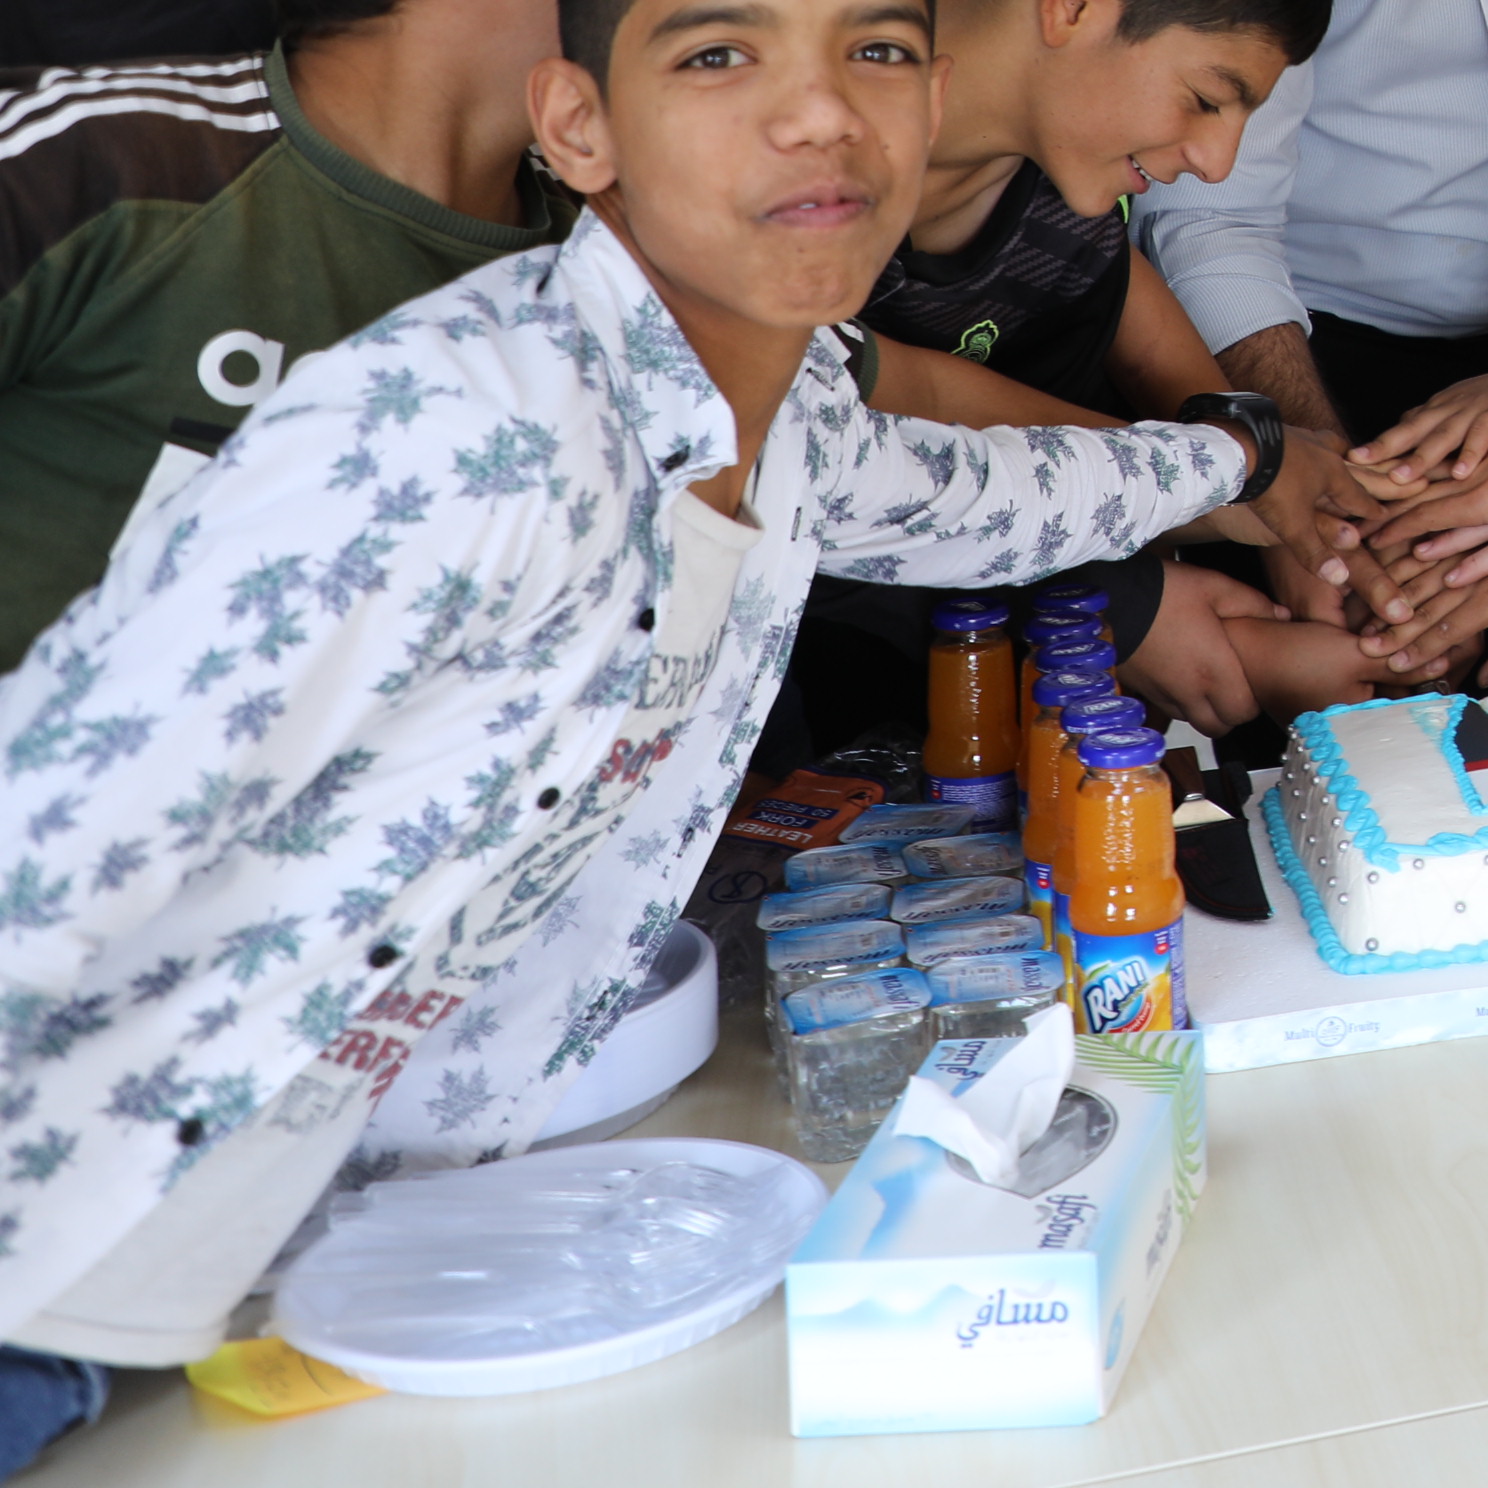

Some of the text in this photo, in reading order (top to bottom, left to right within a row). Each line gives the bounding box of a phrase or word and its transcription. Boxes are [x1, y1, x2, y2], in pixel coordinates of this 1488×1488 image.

[732, 822, 813, 844] LEATHER
[755, 811, 808, 828] FORK
[1086, 961, 1146, 1031] RANI
[1038, 1193, 1097, 1250] masafi
[956, 1288, 1069, 1348] مسافي
